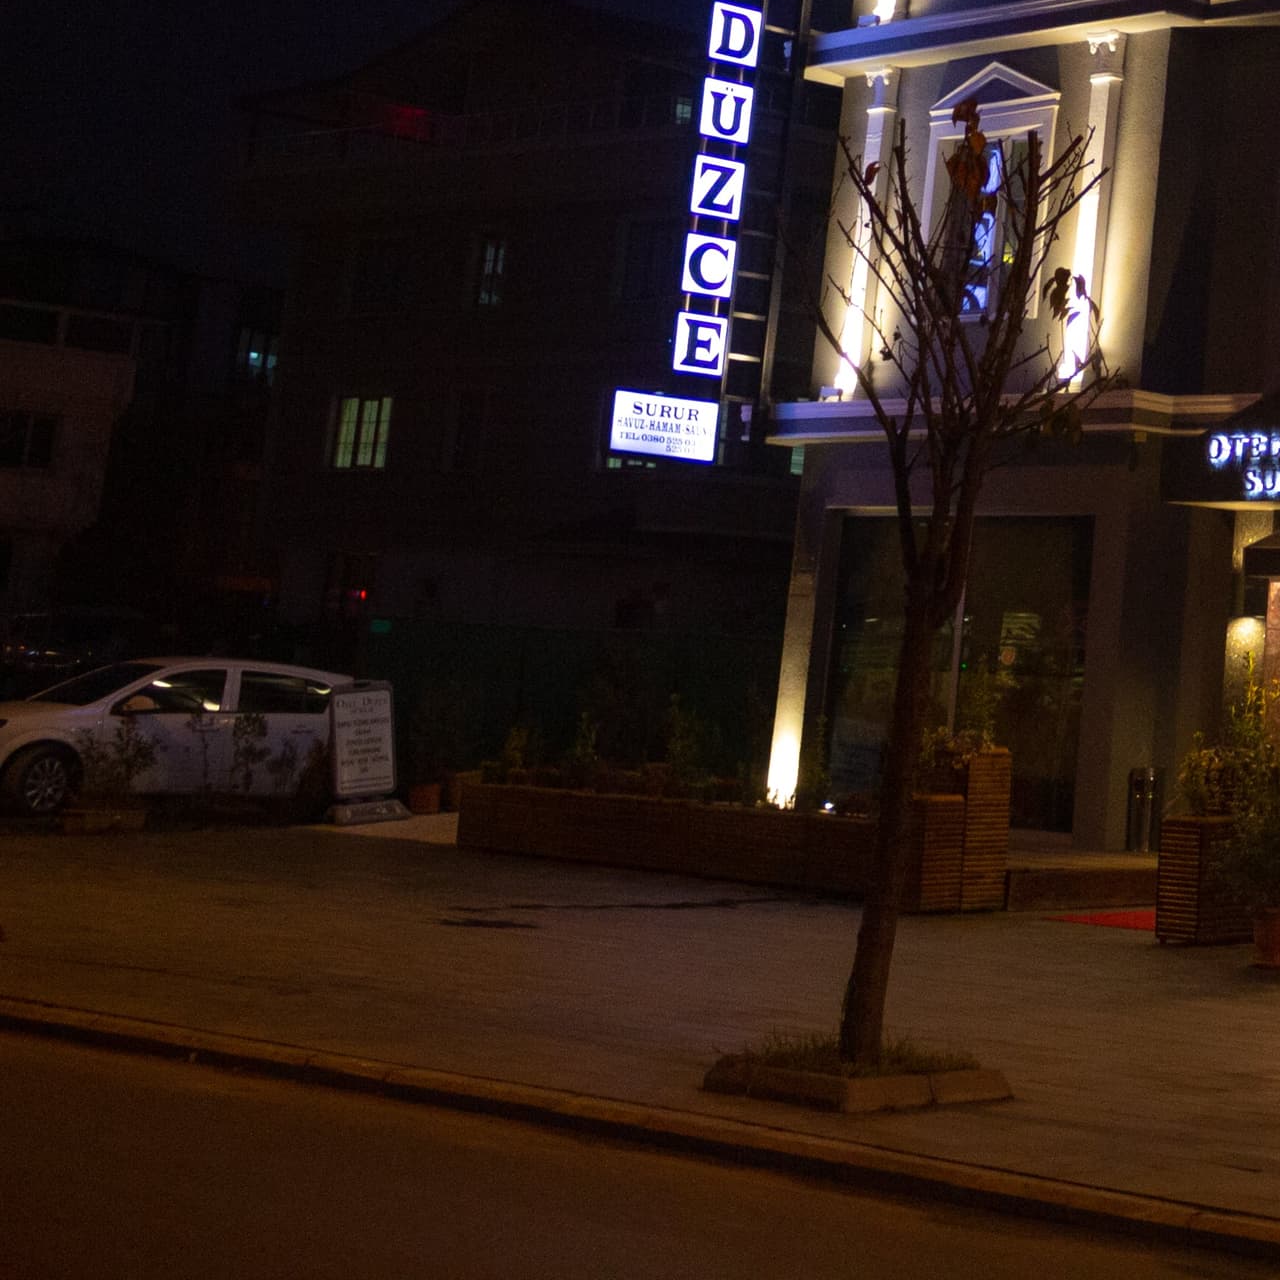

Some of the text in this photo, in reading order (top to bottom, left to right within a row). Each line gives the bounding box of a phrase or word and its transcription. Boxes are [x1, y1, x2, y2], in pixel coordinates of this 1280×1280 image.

[681, 8, 755, 370] DÜZCE
[632, 401, 699, 422] SURUR
[641, 433, 666, 444] 0380
